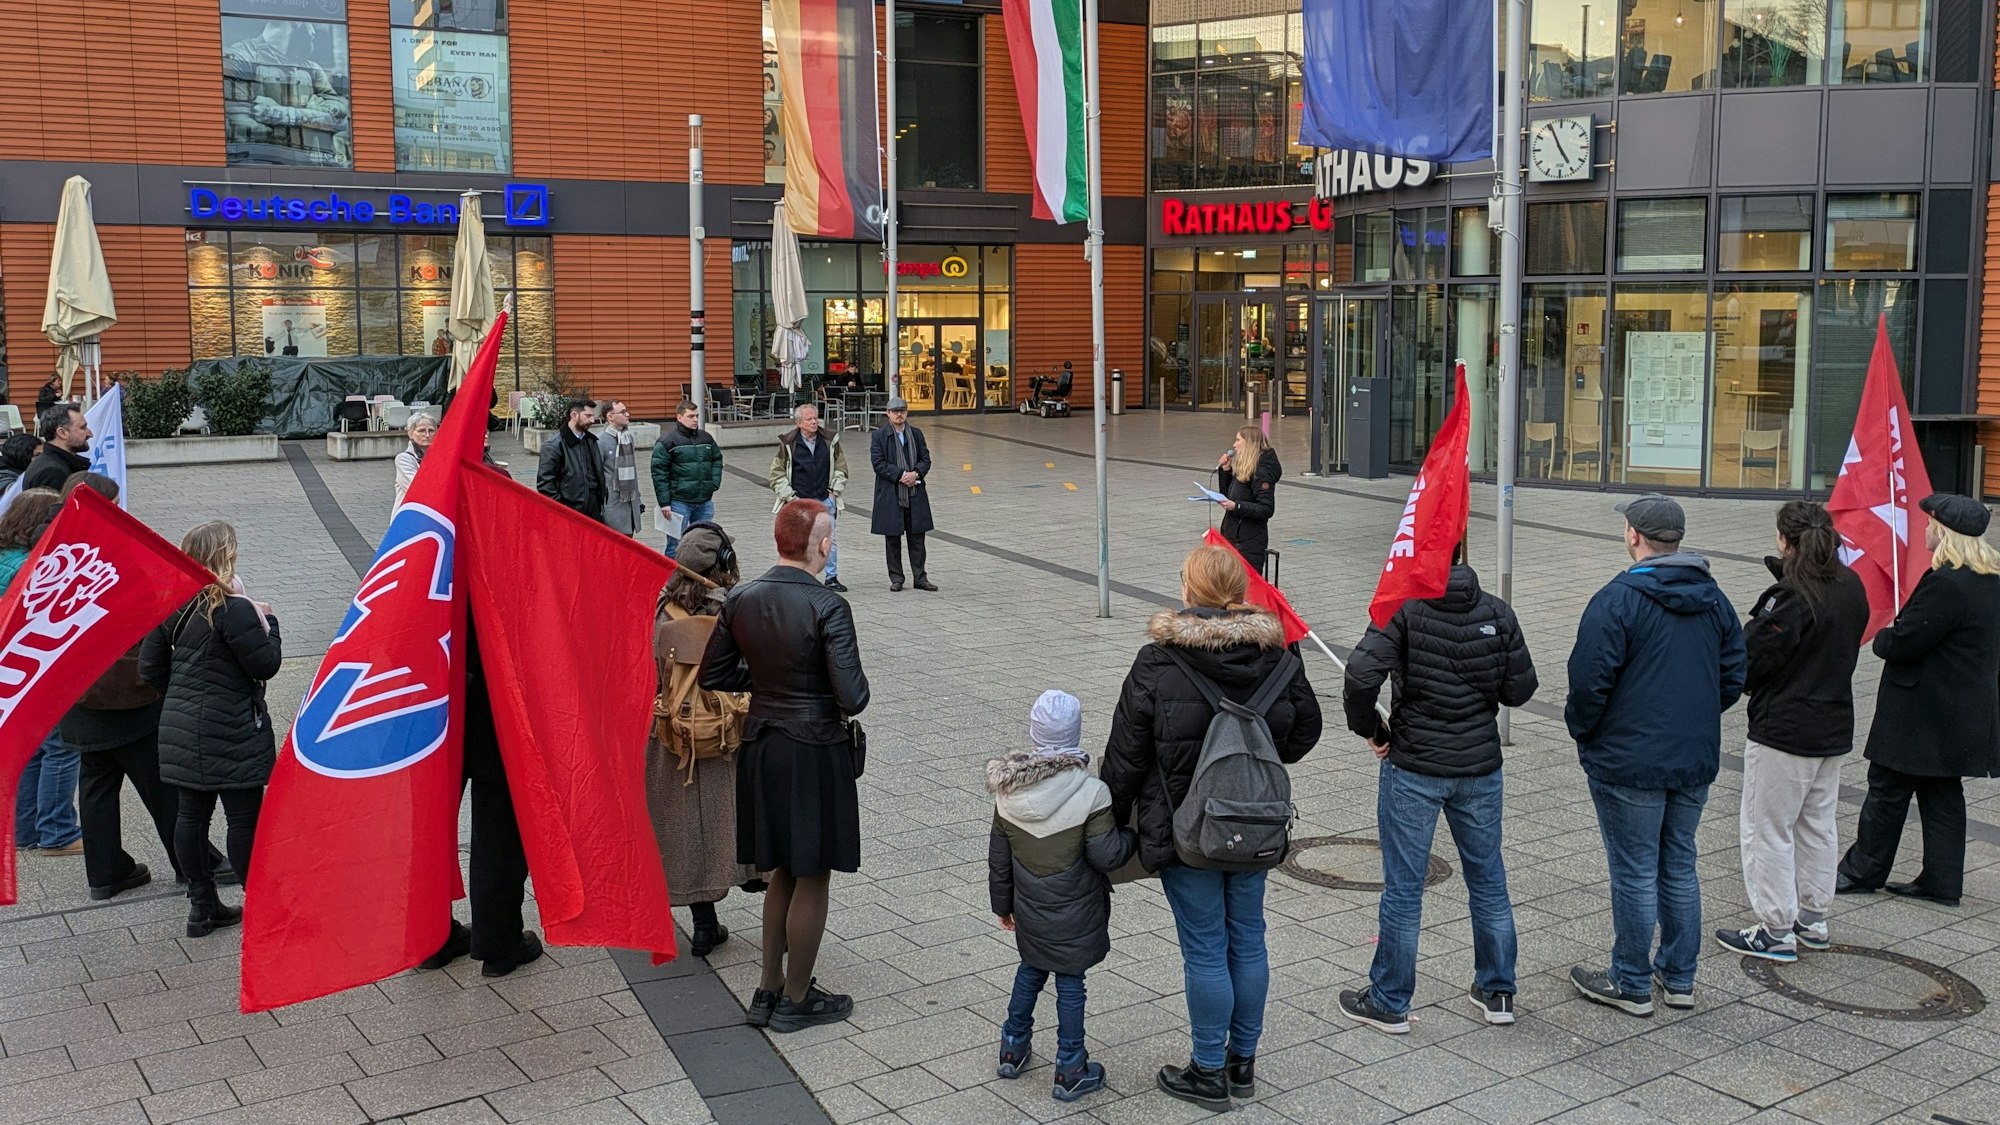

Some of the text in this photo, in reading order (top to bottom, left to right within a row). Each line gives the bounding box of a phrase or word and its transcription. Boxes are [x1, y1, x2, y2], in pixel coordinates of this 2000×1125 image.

[1315, 149, 1431, 200] ATHAUS
[191, 187, 464, 225] Deutsche Ban
